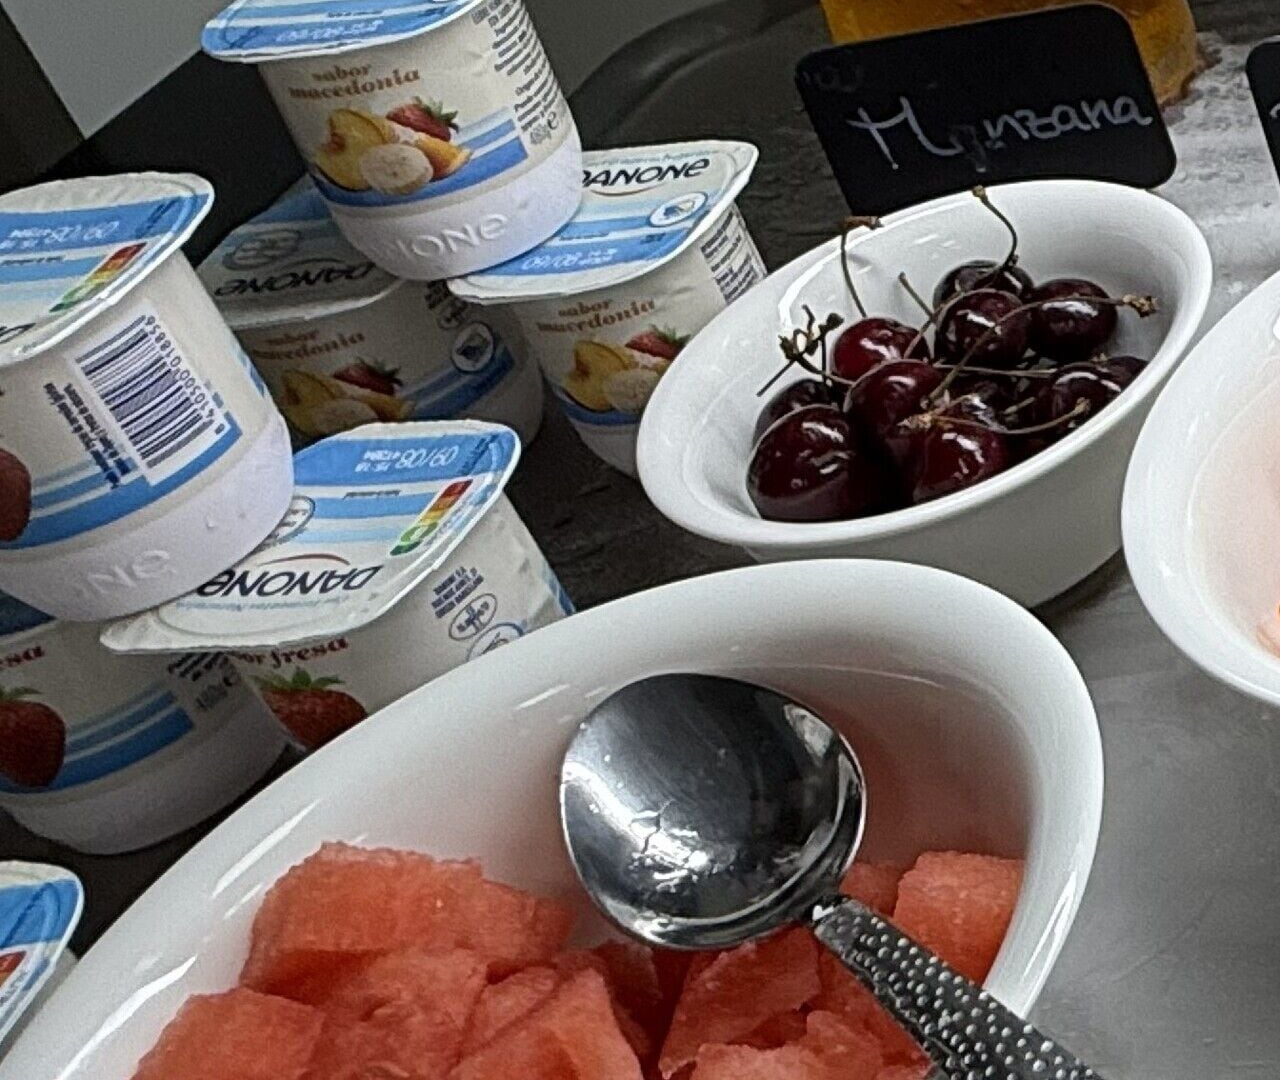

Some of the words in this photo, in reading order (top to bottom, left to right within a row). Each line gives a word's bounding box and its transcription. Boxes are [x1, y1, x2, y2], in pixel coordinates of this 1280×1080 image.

[288, 69, 421, 100] macedonia
[312, 63, 372, 83] sabor
[271, 638, 348, 669] fresa
